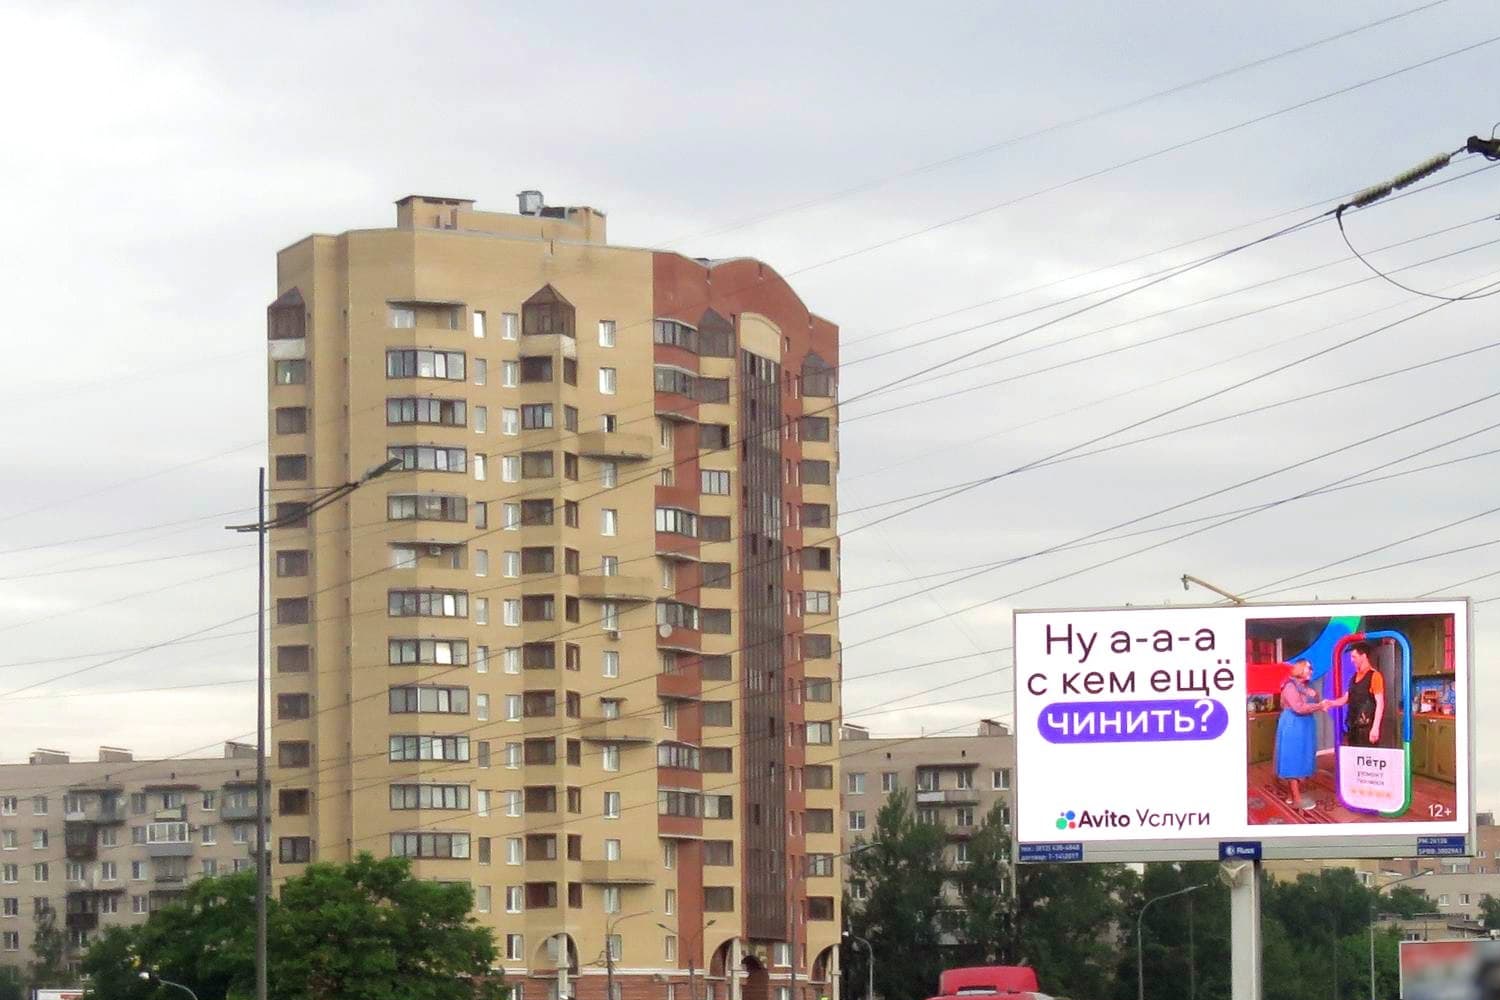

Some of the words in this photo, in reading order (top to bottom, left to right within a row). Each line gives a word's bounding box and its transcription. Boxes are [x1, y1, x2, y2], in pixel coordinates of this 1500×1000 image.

[1046, 623, 1098, 664] Ну
[1110, 628, 1216, 654] а-а-а
[1027, 672, 1048, 696] с
[1062, 671, 1135, 694] кем
[1150, 659, 1235, 697] ещё
[1047, 699, 1215, 736] чинить?
[1356, 756, 1387, 770] Пётр
[1078, 809, 1131, 829] Avito
[1135, 808, 1211, 831] Услуги
[1428, 804, 1452, 817] 12+
